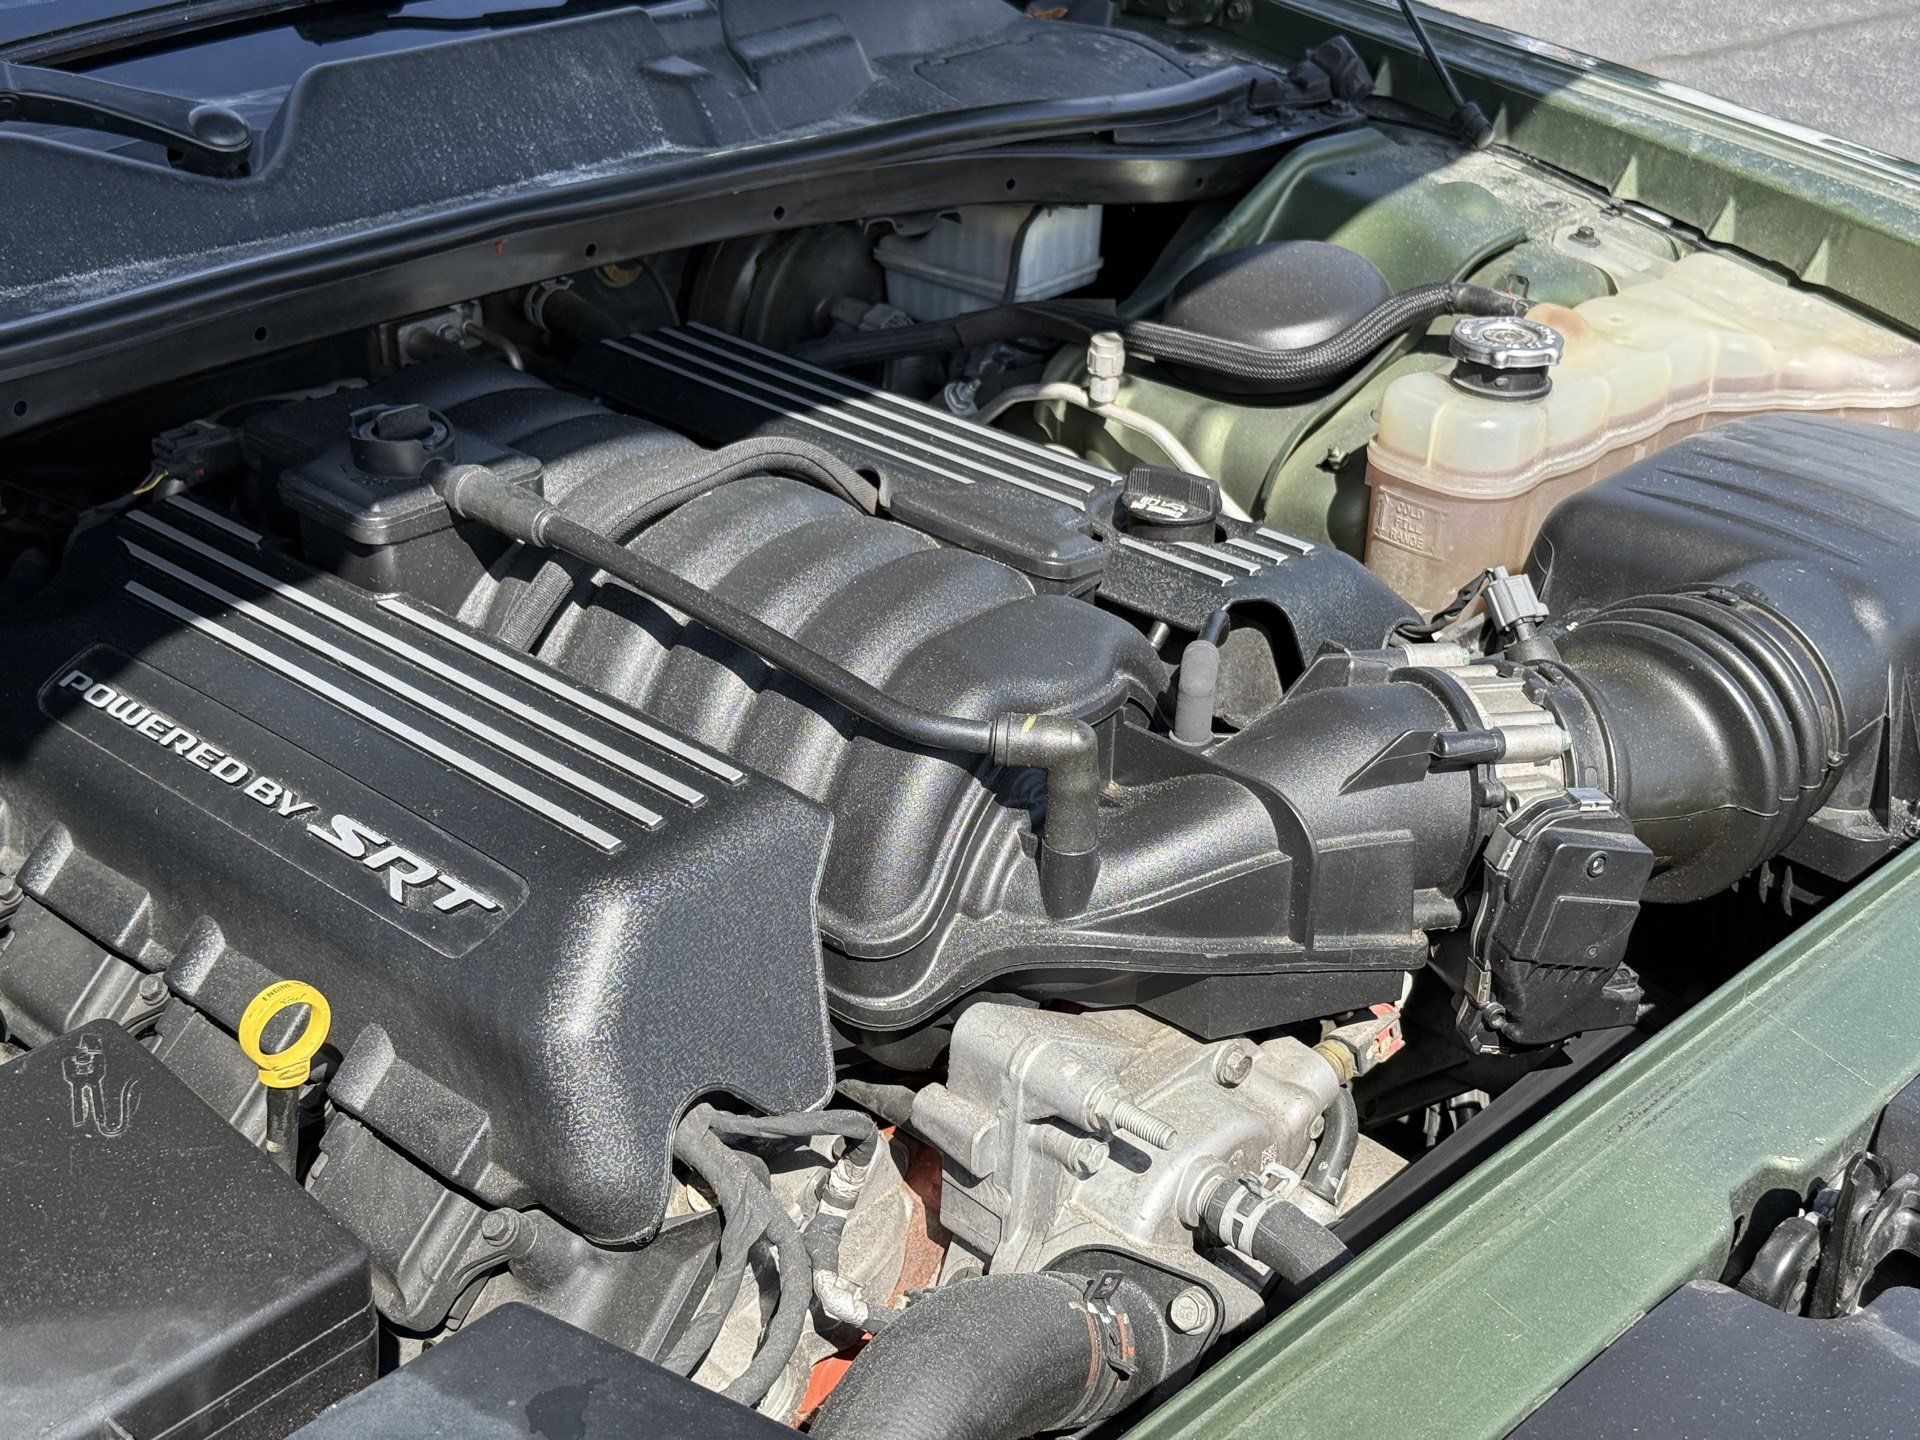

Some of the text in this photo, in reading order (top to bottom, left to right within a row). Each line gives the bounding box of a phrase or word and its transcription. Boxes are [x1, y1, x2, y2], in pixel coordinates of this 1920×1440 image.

[1396, 502, 1425, 520] COLD
[1389, 530, 1425, 549] RANGE
[58, 669, 500, 913] POWERED BY SRT
